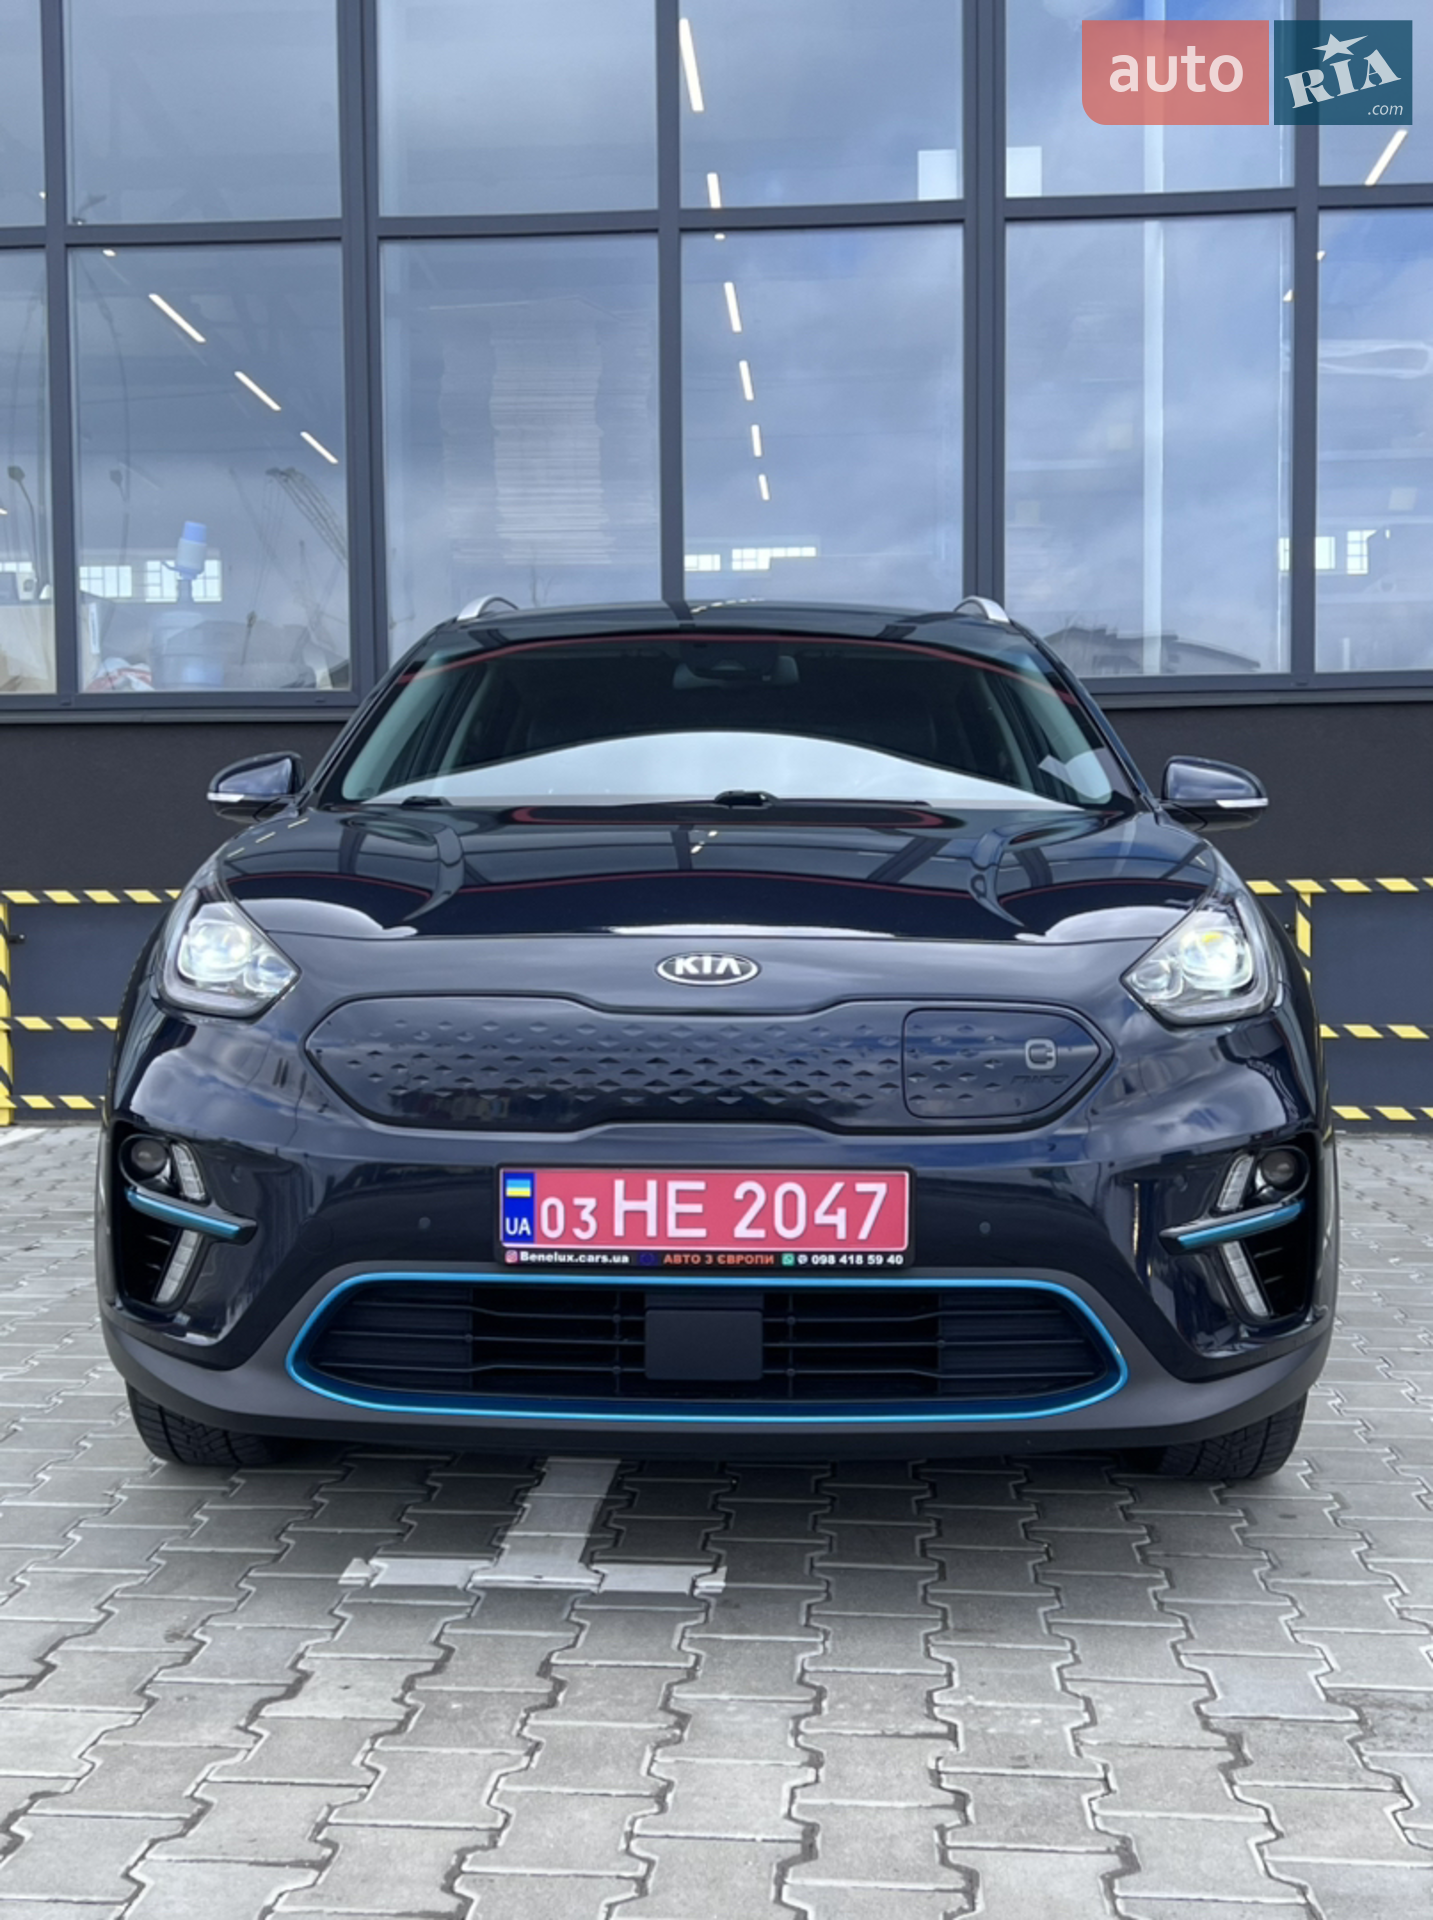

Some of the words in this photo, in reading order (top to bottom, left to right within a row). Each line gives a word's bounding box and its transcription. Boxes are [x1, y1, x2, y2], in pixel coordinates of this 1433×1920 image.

[674, 955, 741, 975] KIA
[540, 1197, 598, 1240] 03
[613, 1179, 707, 1239] HE
[733, 1181, 888, 1240] 2047
[505, 1217, 532, 1236] UA
[520, 1251, 630, 1265] Benelux.cars.ua
[663, 1254, 702, 1265] АВТО
[811, 1254, 836, 1265] 098
[839, 1254, 864, 1265] 418
[867, 1254, 884, 1265] 59
[886, 1254, 904, 1265] 40
